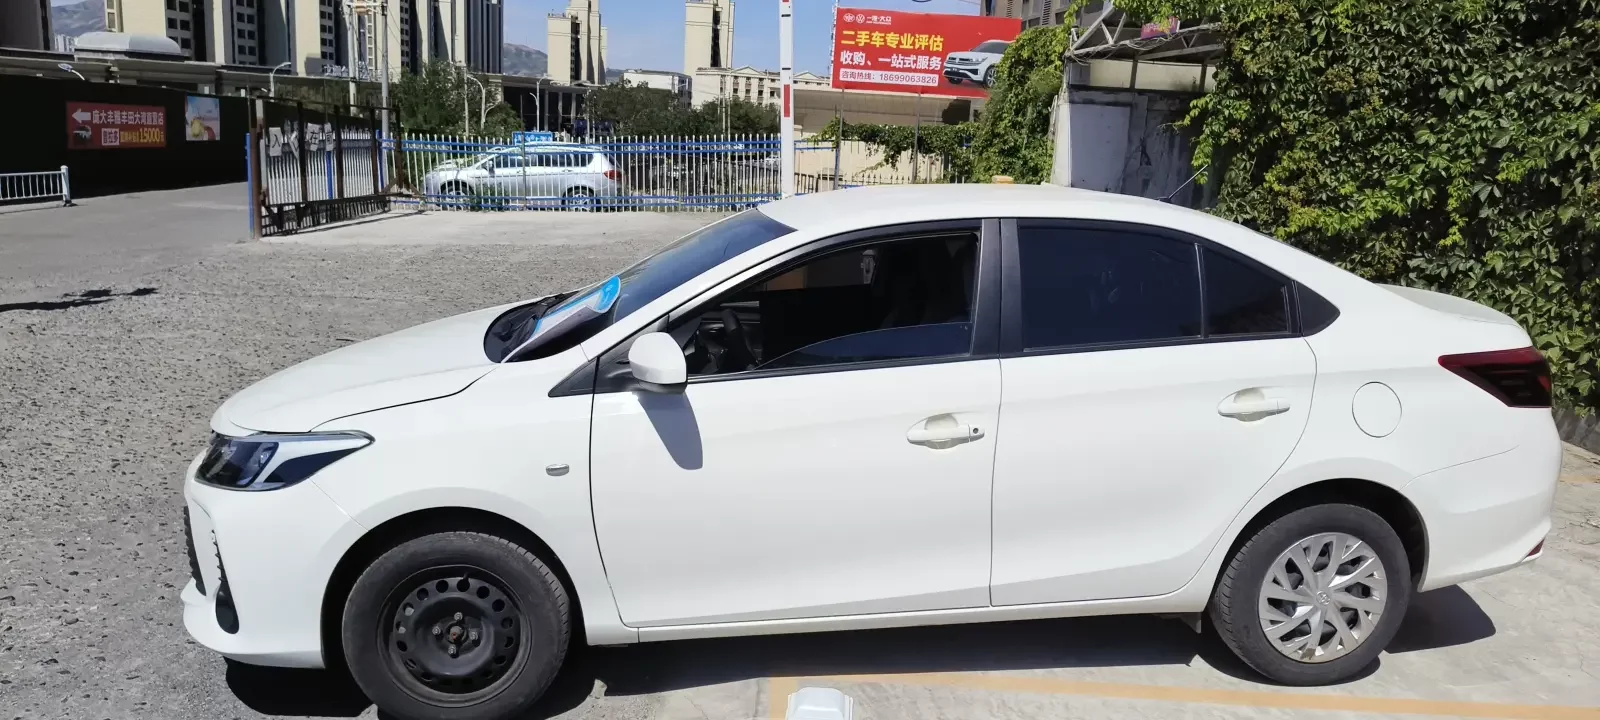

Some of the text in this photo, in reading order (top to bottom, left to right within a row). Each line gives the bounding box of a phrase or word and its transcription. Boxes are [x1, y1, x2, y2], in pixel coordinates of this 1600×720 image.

[841, 30, 944, 52] 二手车专业评估
[840, 50, 942, 71] 收购、一站式服务
